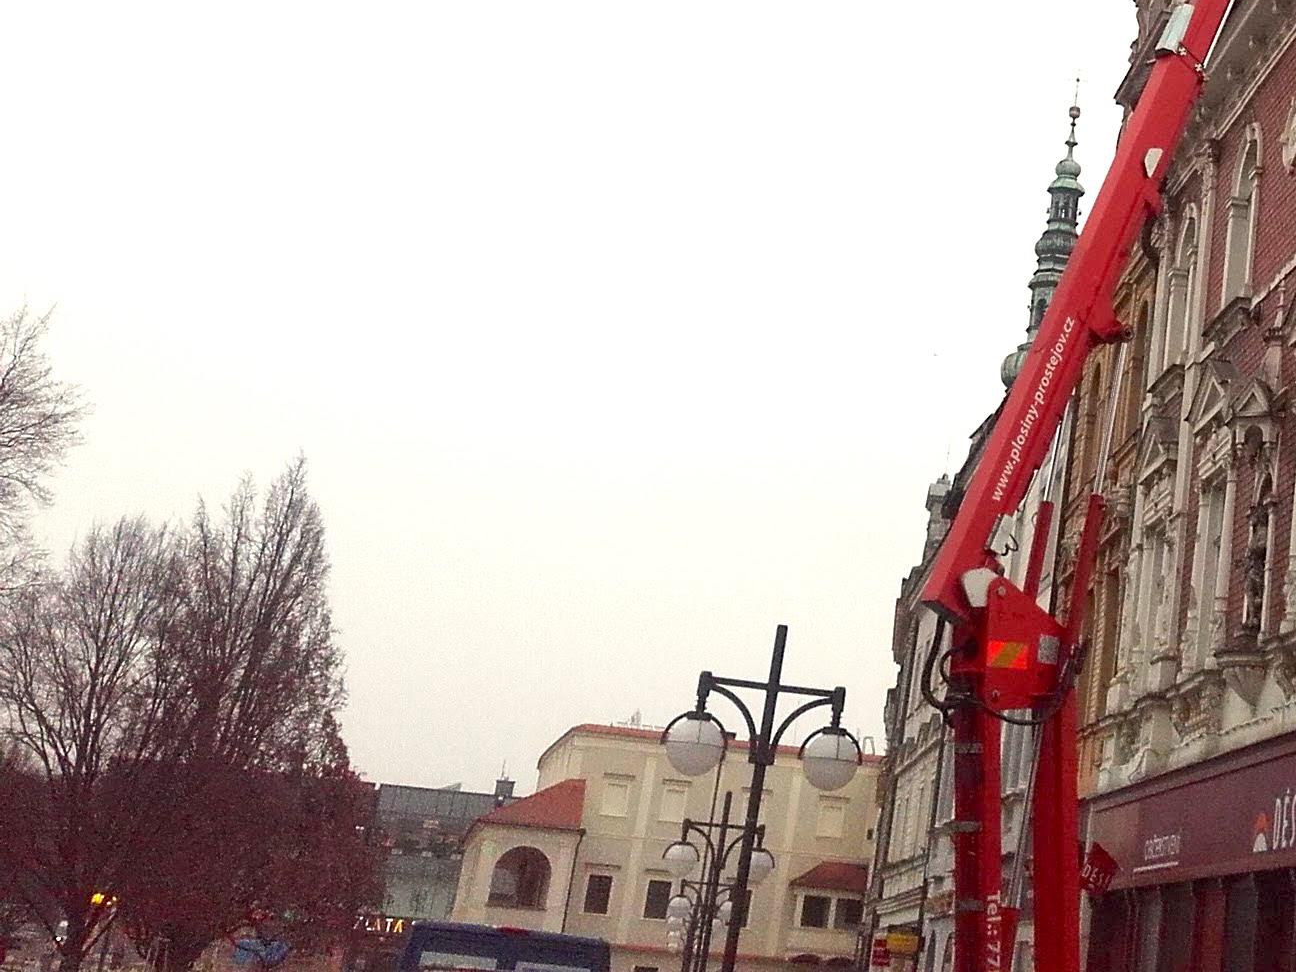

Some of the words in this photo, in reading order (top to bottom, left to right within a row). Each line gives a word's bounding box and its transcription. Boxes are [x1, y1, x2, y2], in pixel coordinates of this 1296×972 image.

[992, 316, 1075, 502] www.plosiny-prostejov.cz
[986, 889, 1002, 936] Tel.:
[986, 940, 1002, 972] 77
